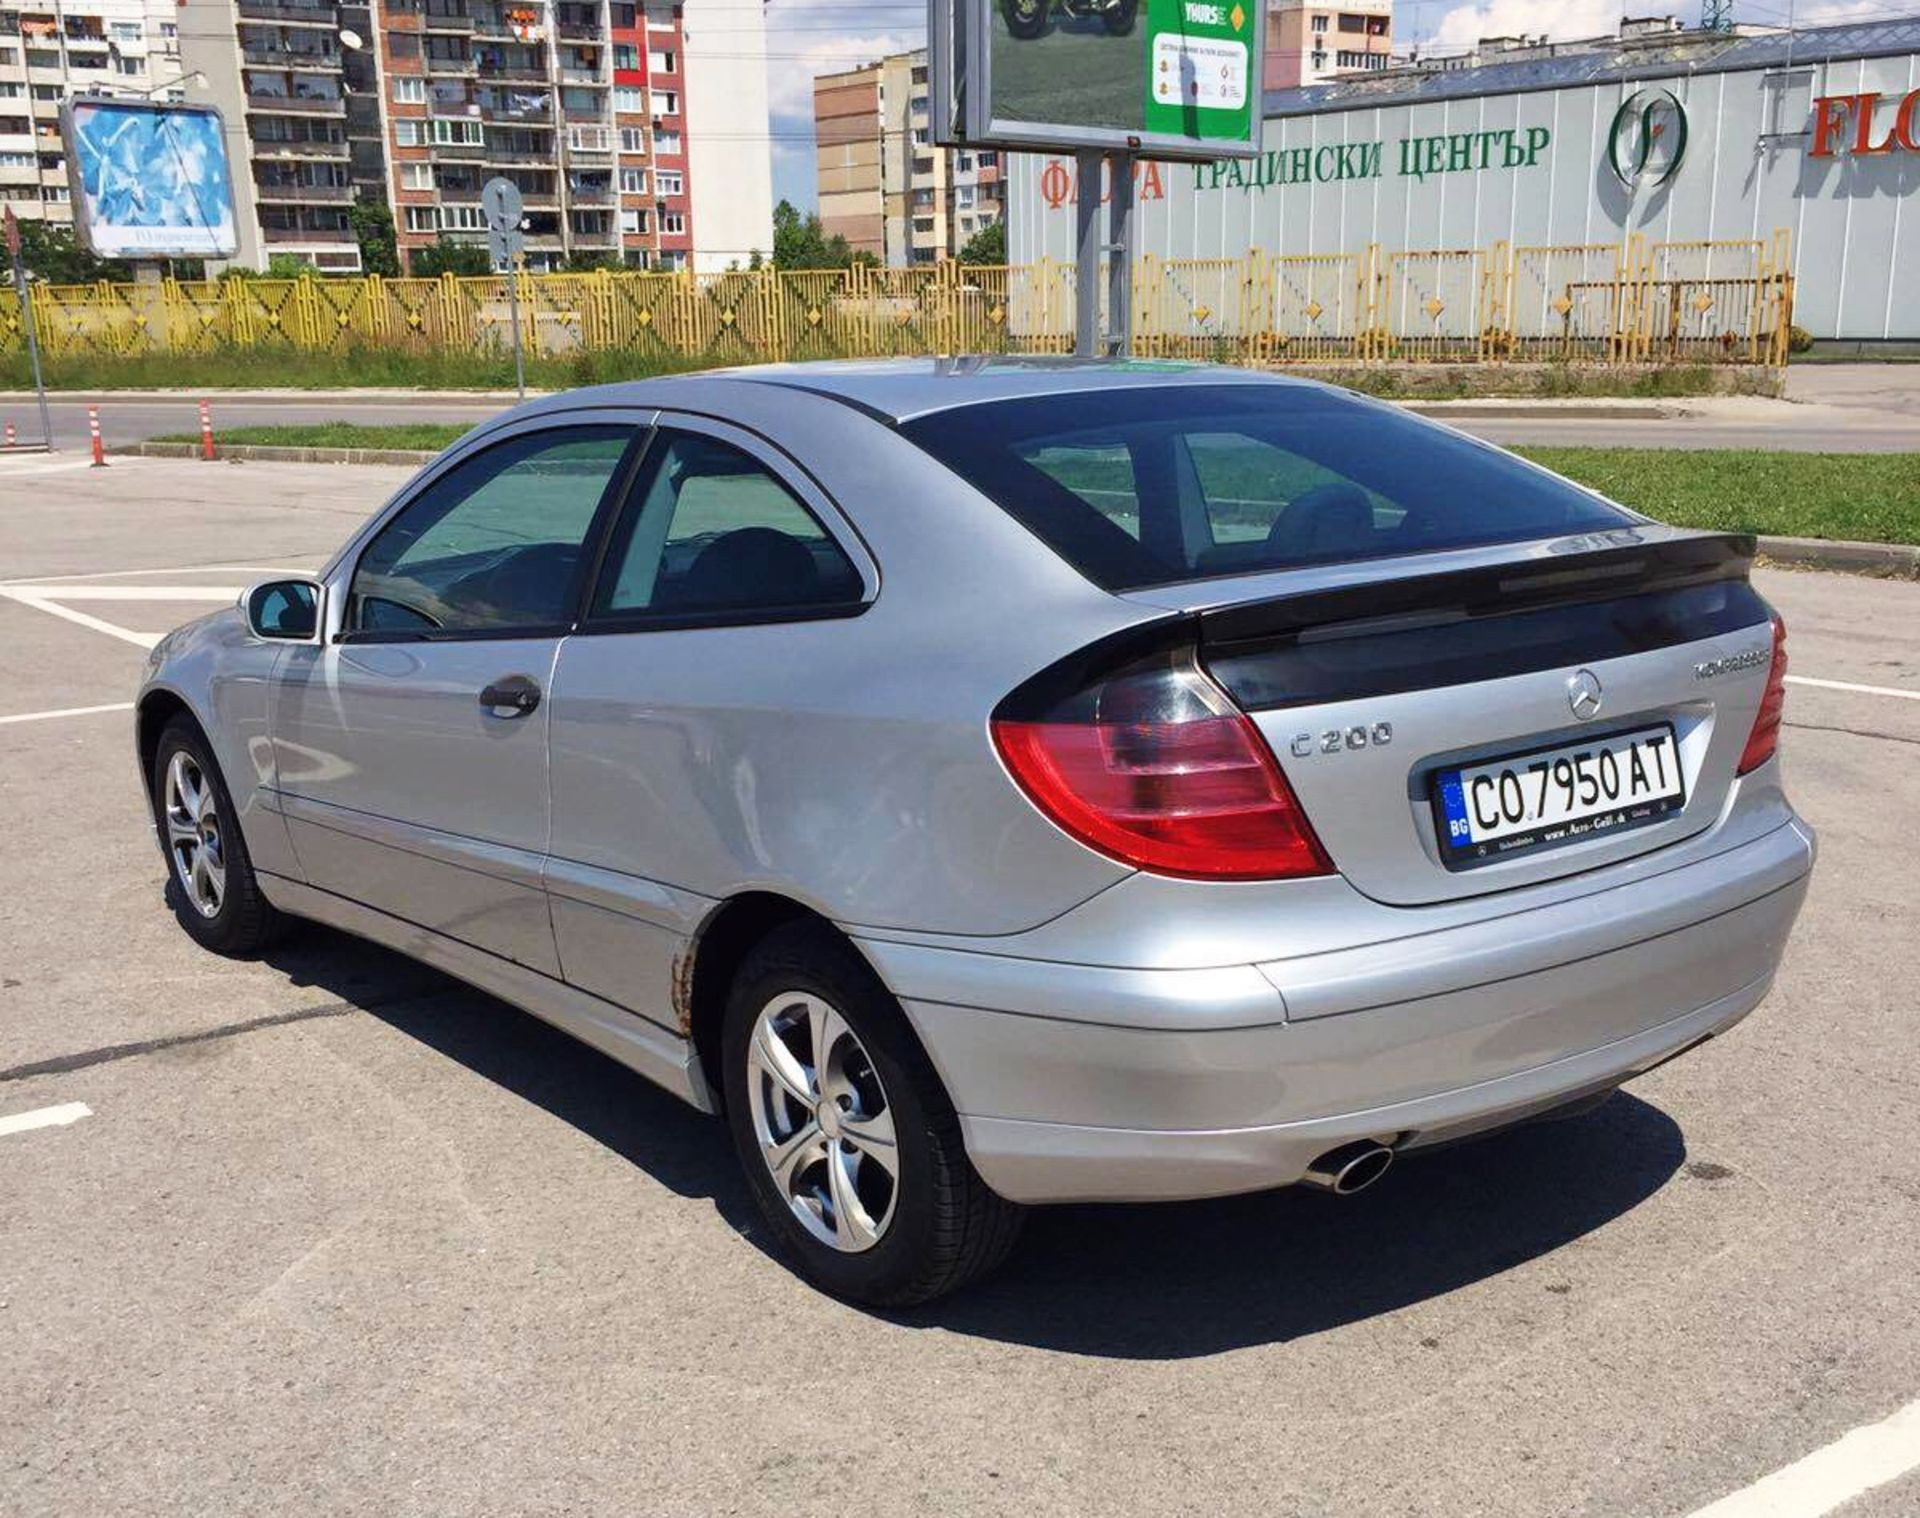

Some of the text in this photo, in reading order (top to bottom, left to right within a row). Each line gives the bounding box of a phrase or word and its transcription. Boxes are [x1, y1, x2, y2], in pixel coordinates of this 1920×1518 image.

[1397, 127, 1550, 184] ЦЕНТЪР
[1291, 722, 1393, 757] C 200
[1450, 819, 1469, 837] BG
